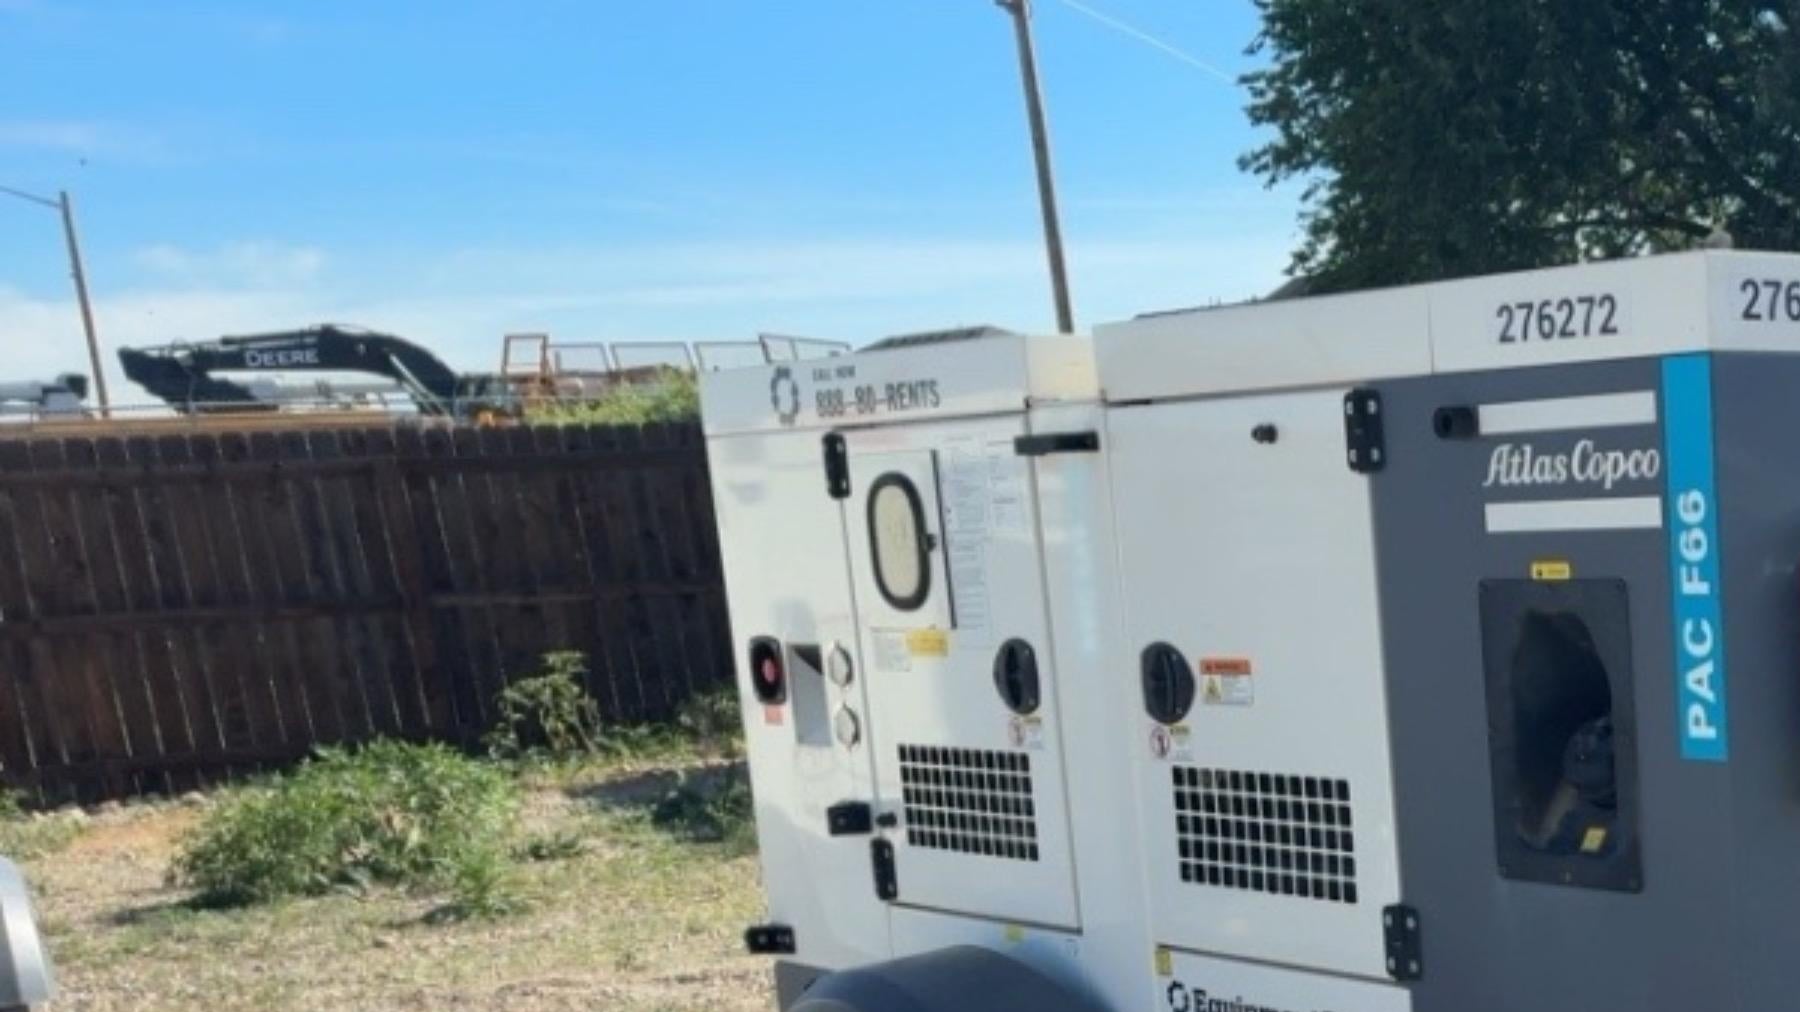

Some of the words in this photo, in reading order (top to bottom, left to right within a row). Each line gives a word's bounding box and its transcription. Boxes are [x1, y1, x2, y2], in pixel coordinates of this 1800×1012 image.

[1496, 294, 1619, 343] 276272
[246, 348, 319, 367] DEERE
[815, 378, 940, 417] 888-80-RENTS
[1483, 443, 1567, 487] Atlas
[1571, 439, 1660, 490] Copco
[1676, 488, 1711, 596] F66
[1682, 617, 1718, 740] PAC
